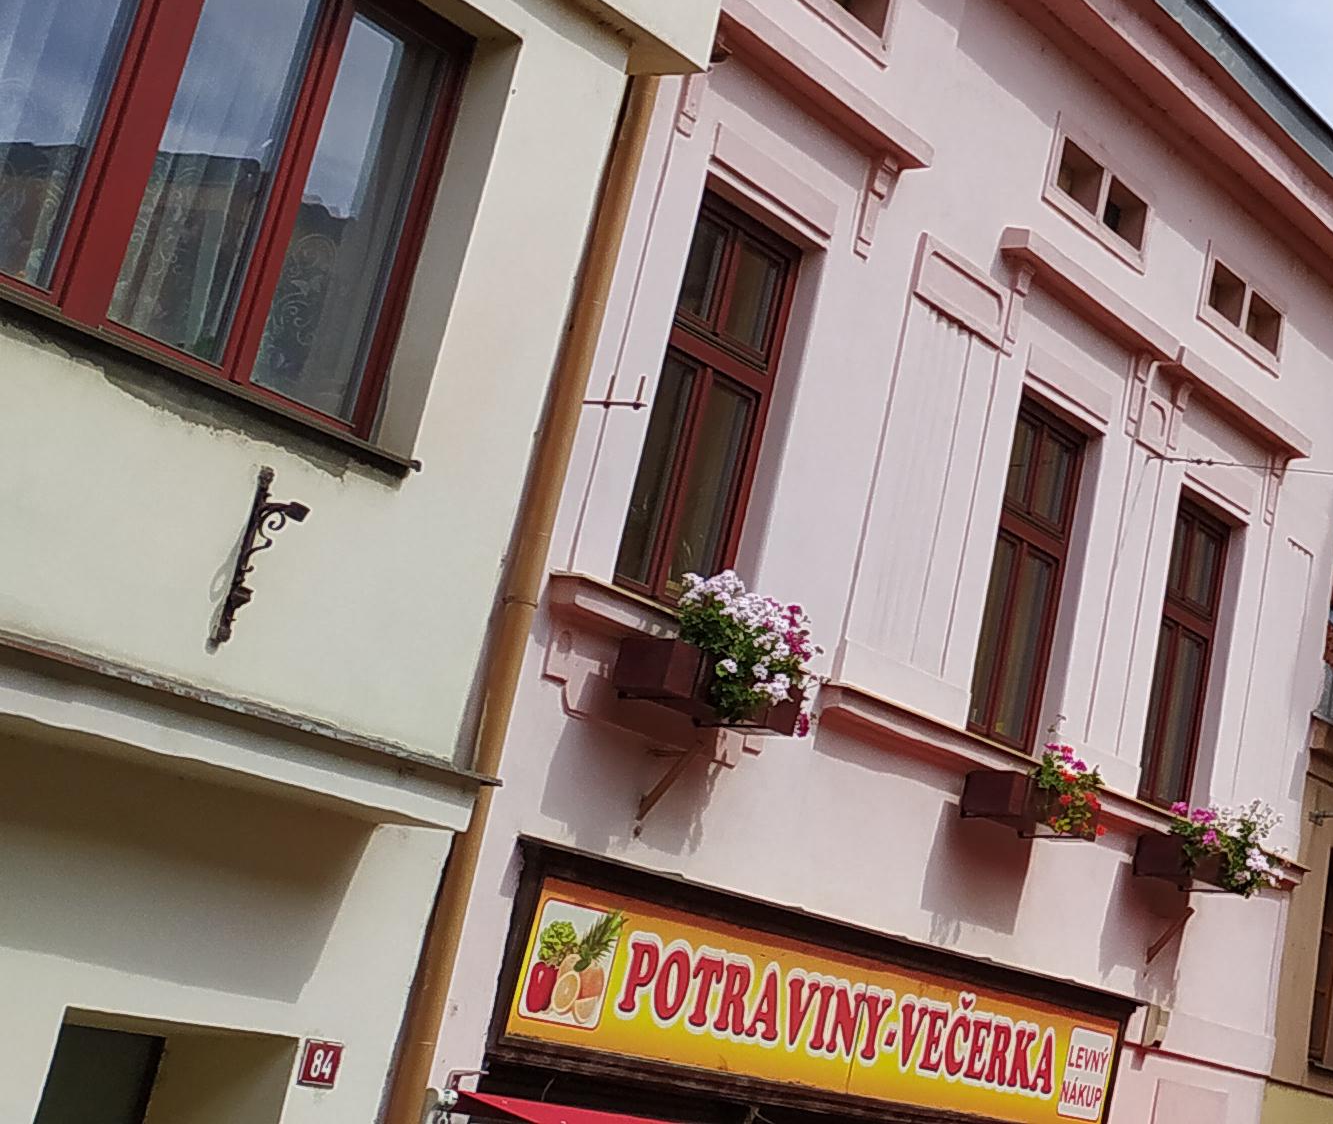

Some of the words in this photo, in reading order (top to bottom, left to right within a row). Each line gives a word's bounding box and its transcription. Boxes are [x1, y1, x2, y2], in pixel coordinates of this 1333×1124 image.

[310, 1049, 334, 1079] 84
[1068, 1044, 1109, 1074] LEVNÝ
[1060, 1077, 1102, 1108] NÁKUP
